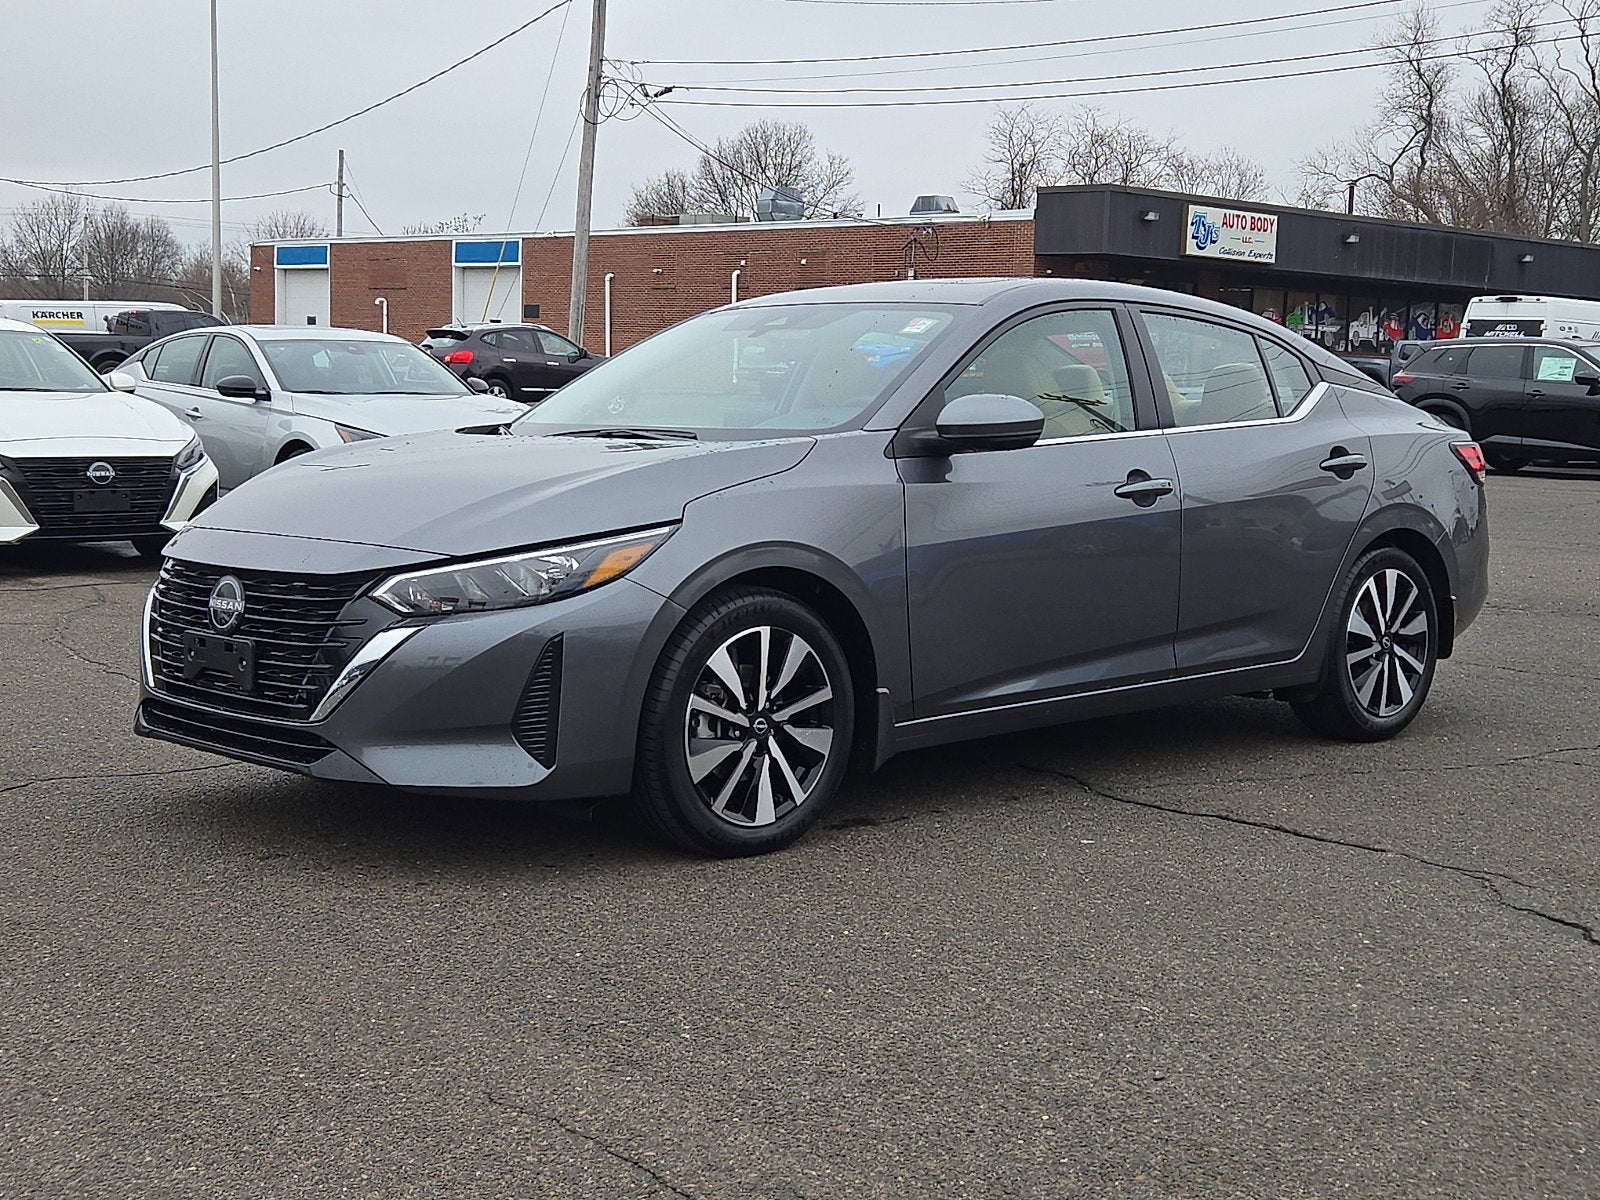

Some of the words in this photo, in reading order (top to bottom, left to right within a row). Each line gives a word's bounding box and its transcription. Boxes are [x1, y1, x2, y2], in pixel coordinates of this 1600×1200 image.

[1221, 213, 1247, 230] AUTO
[1250, 215, 1275, 233] BODY
[1218, 246, 1246, 258] Collision
[1247, 249, 1274, 260] Experts
[209, 598, 243, 612] NISSAN
